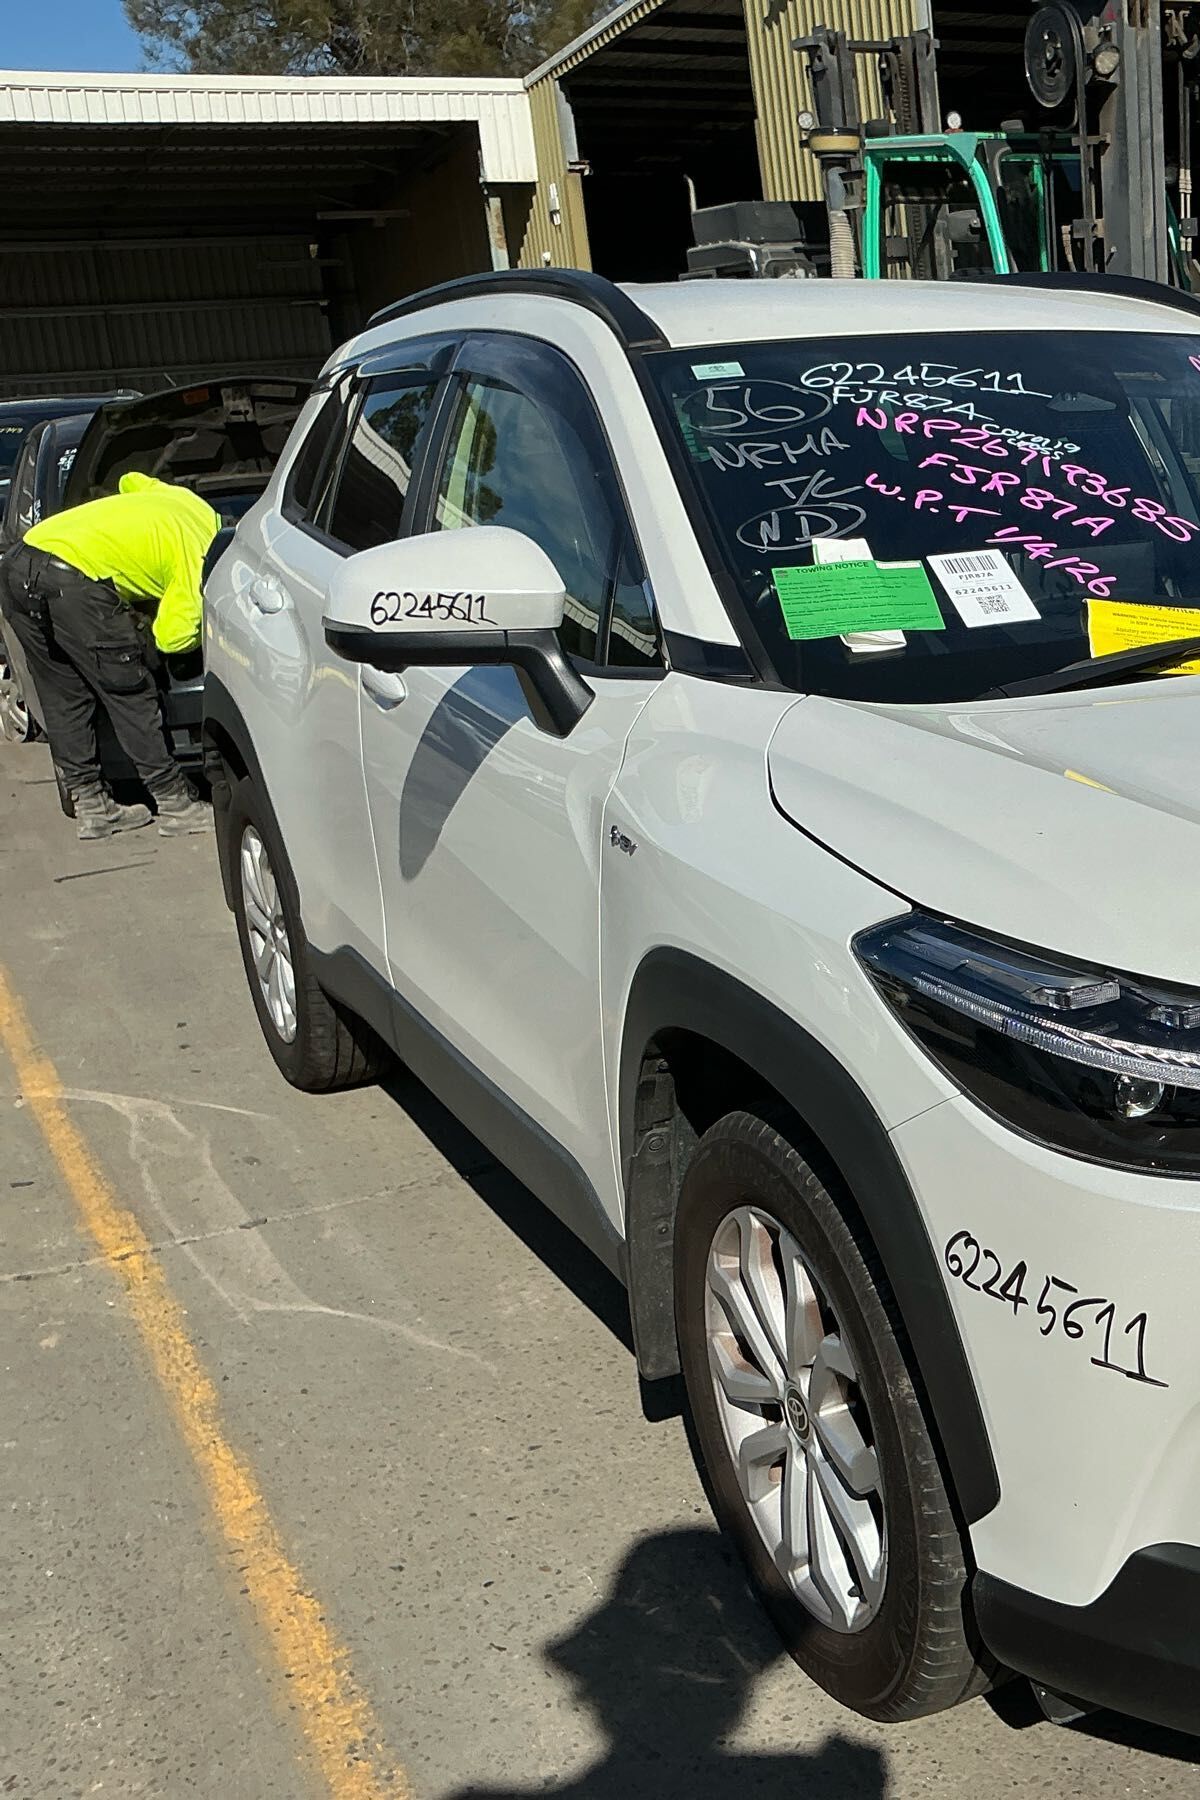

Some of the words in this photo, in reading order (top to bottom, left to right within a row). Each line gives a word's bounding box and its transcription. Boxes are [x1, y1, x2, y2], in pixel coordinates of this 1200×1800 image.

[800, 362, 1053, 399] 62245611
[699, 385, 806, 431] 56
[832, 386, 995, 421] FJR87A
[706, 426, 852, 472] NRMA
[795, 564, 833, 575] TOWING
[835, 561, 869, 571] NOTICE
[958, 571, 994, 581] FJR87A
[954, 583, 1014, 596] 62245611
[370, 591, 498, 626] 62245611
[944, 1229, 1170, 1389] 62245611
